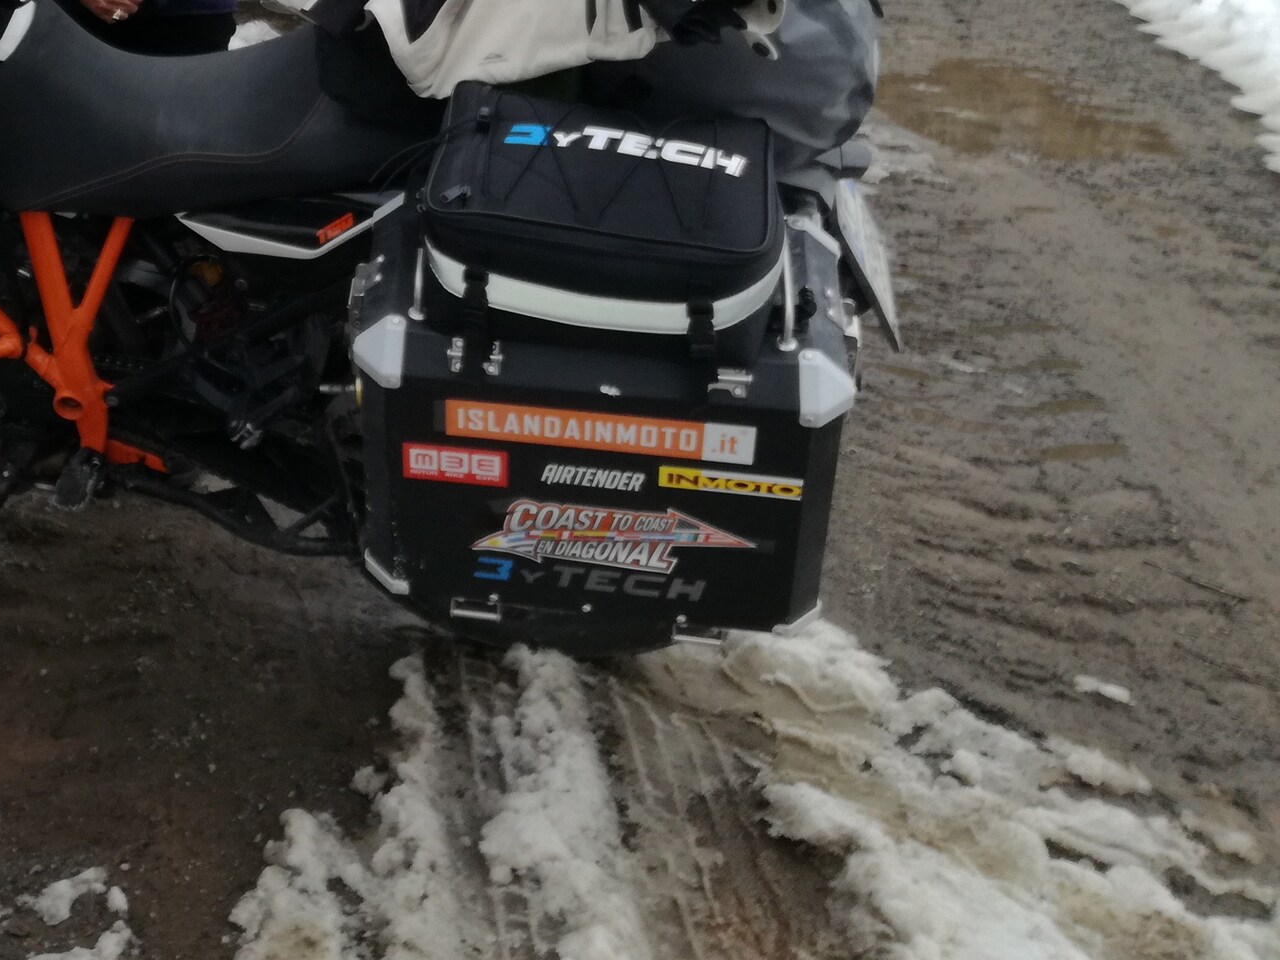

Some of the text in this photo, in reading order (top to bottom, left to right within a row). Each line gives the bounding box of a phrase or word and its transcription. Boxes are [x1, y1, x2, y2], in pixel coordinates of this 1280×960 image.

[540, 463, 646, 492] AIRTENDER
[667, 472, 802, 498] INMOTO
[509, 504, 674, 532] COAST TO COAST
[537, 540, 672, 569] EN DIAGONAL
